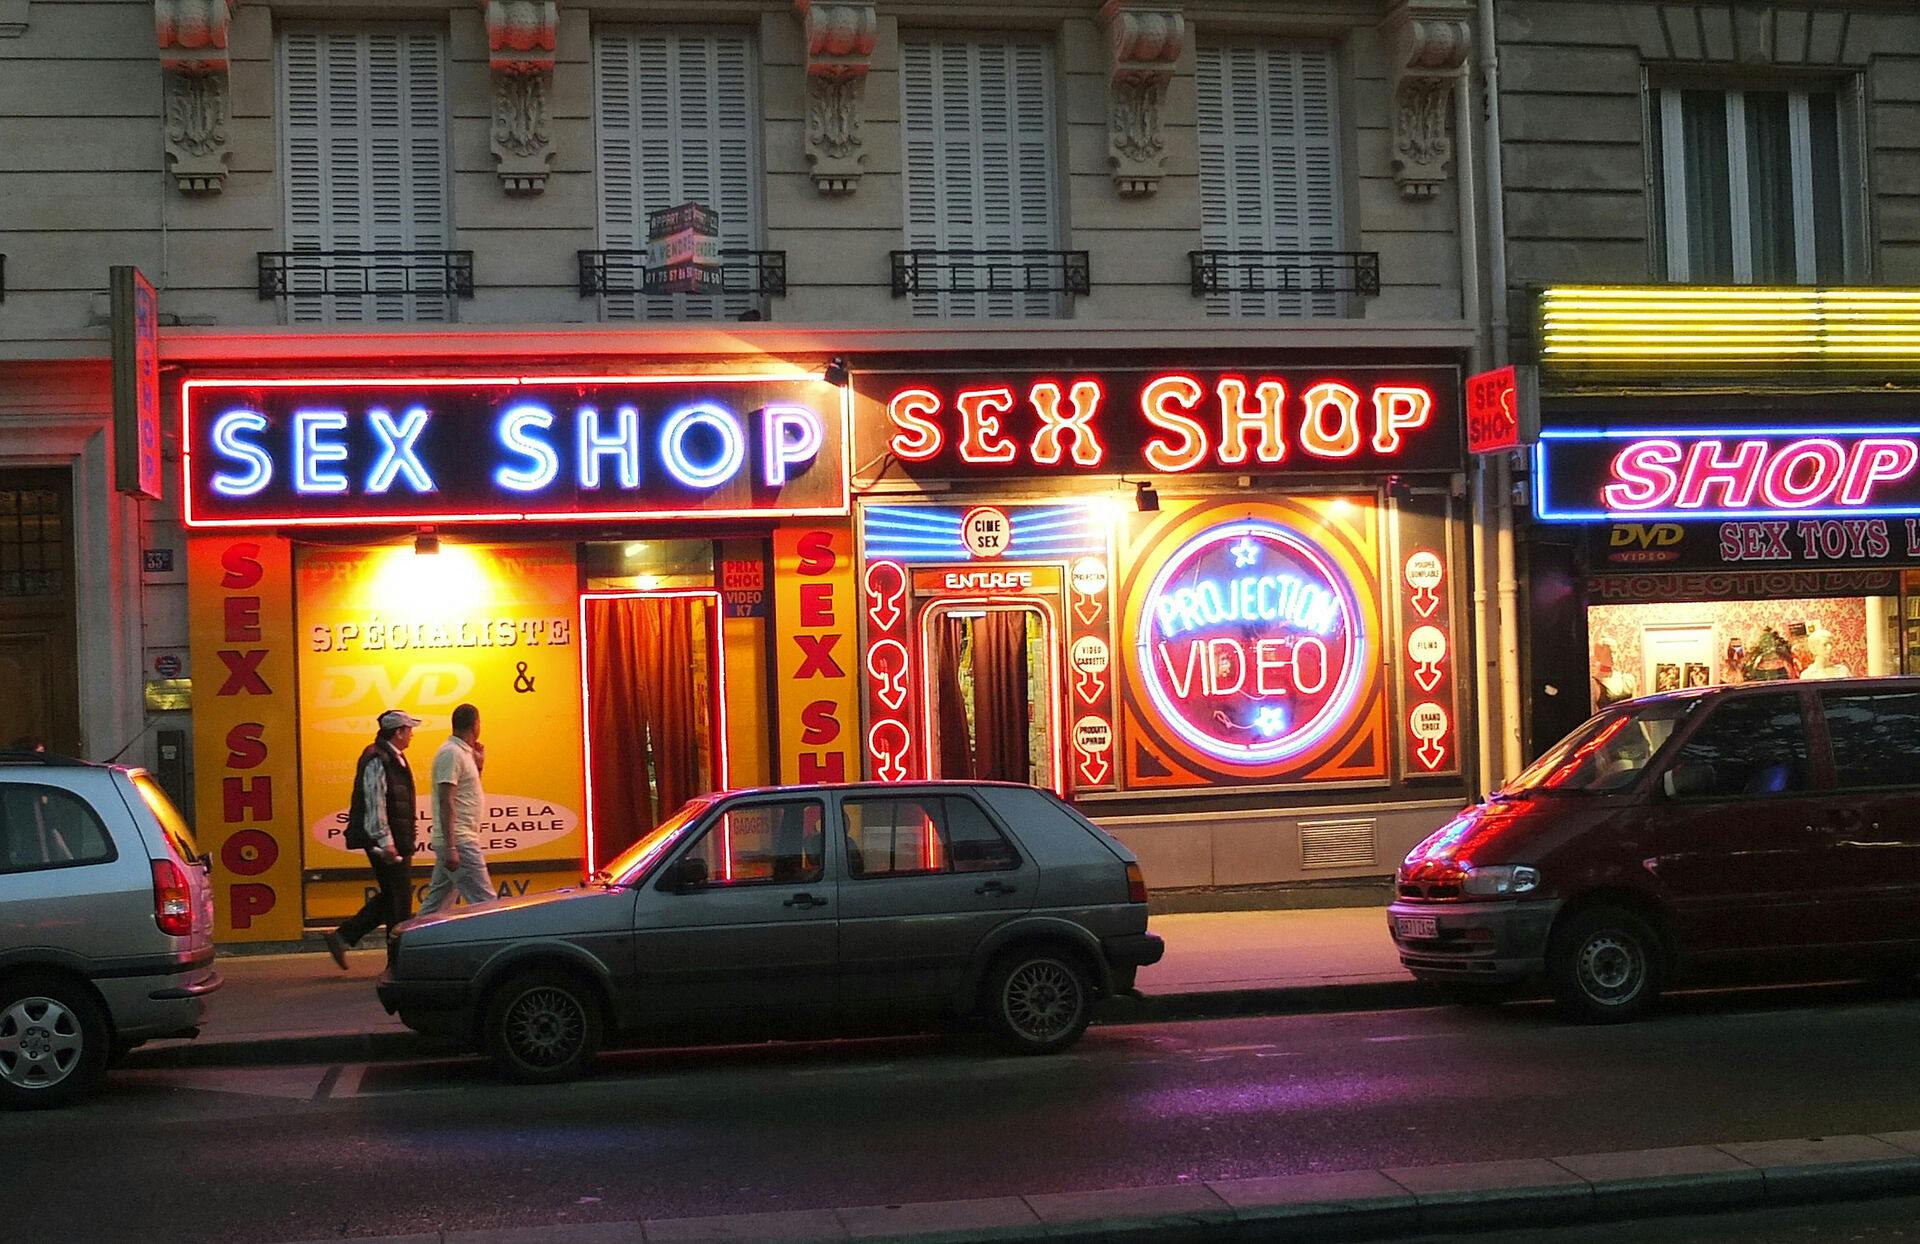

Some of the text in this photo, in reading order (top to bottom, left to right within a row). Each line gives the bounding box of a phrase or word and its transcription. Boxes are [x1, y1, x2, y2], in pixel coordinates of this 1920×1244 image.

[887, 374, 1432, 473] SEX SHOP
[210, 402, 824, 497] SEX SHOP
[1601, 437, 1919, 510] SHOP
[974, 519, 1001, 532] CINE
[1610, 523, 1685, 550] DVD
[977, 535, 999, 548] SEX
[1719, 521, 1792, 562] SEX
[1797, 519, 1891, 560] TOYS
[727, 560, 758, 573] PRIX
[1621, 551, 1668, 561] VIDEO
[725, 574, 761, 588] CHOC
[1824, 572, 1893, 590] DVD
[727, 591, 762, 604] VIDEO
[793, 530, 846, 680] SEX
[1154, 574, 1342, 638] PROJECTION
[736, 604, 752, 617] K7
[310, 615, 572, 652] SPÉCIALISTE
[1082, 646, 1102, 654] VIDEO
[1077, 657, 1106, 666] CASSETTE
[1158, 636, 1328, 699] VIDEO
[312, 660, 536, 709] DVD &
[216, 542, 280, 931] SEX SHOP
[489, 805, 556, 818] DE LA
